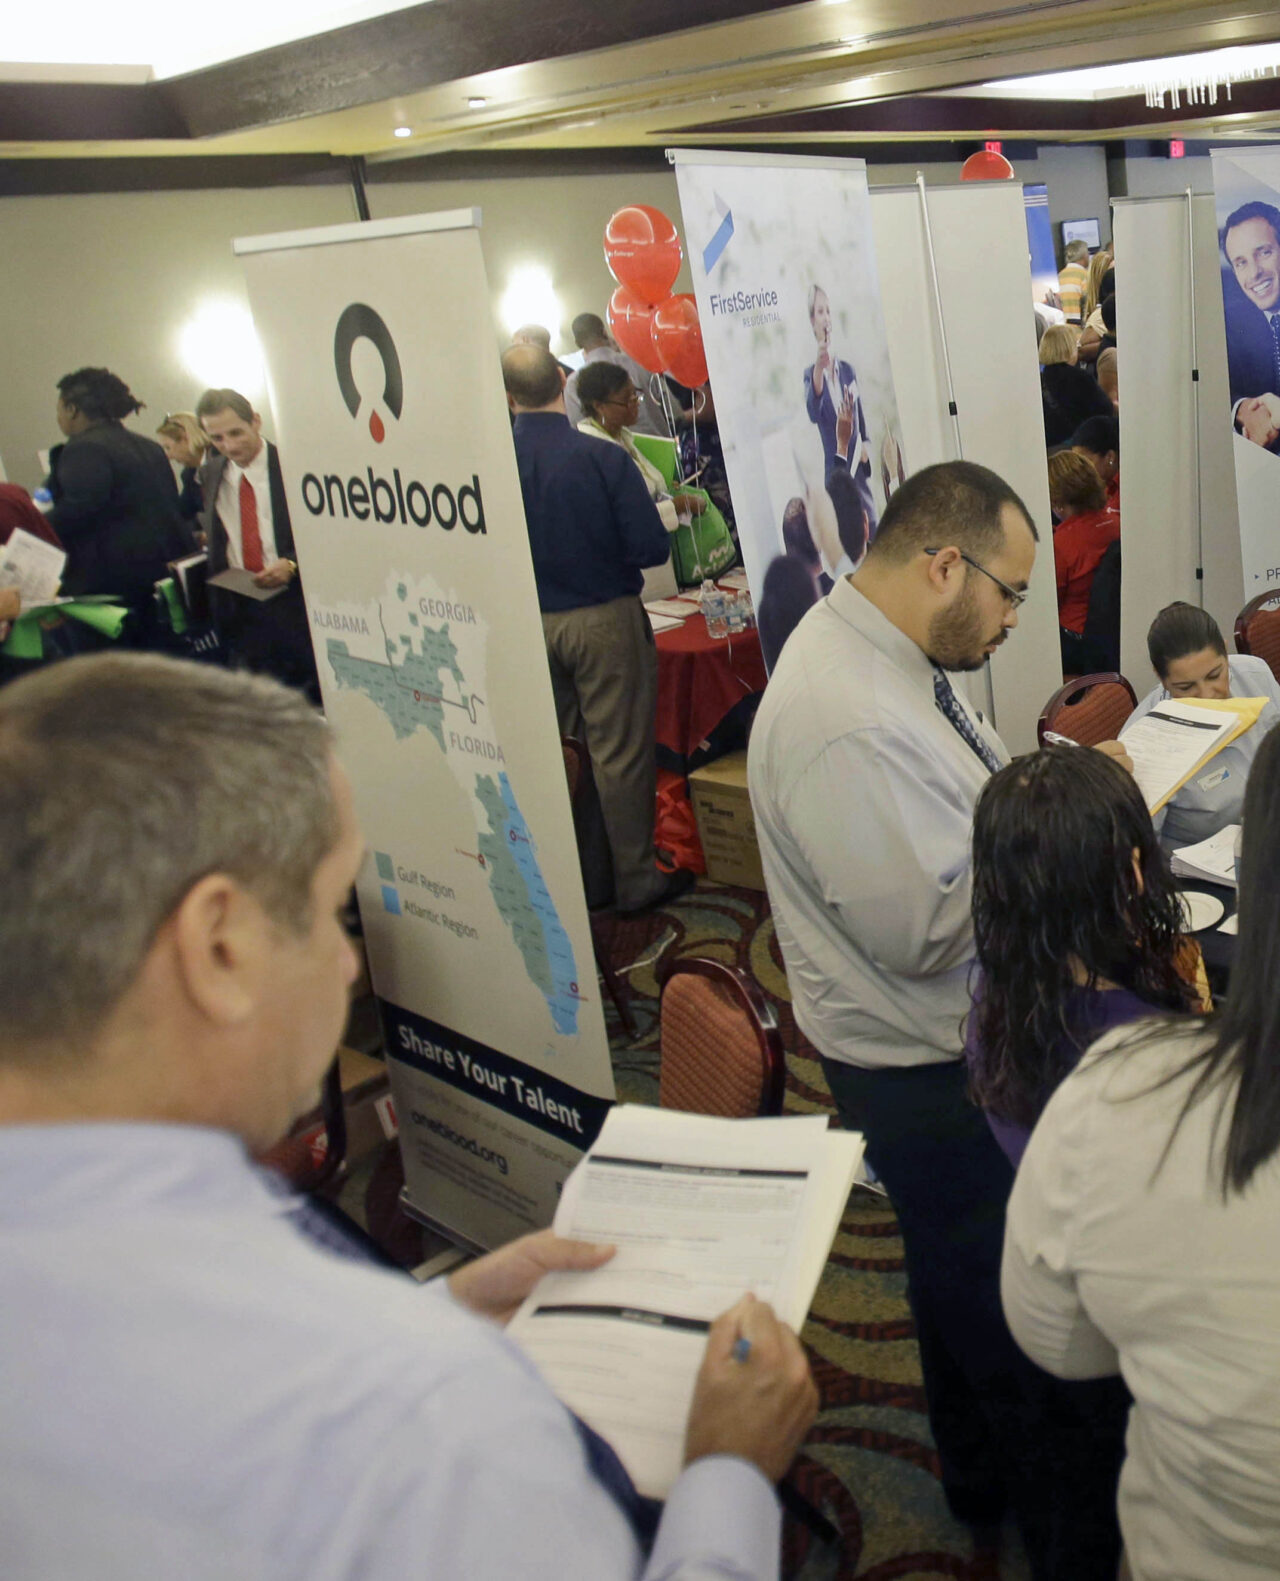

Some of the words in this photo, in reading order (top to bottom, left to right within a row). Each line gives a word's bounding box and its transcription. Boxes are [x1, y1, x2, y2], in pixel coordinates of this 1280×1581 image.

[710, 287, 778, 316] FirstService
[743, 312, 781, 328] RESIDENTIAL
[302, 467, 487, 535] oneblood
[313, 610, 369, 635] ALABAMA
[420, 598, 476, 624] GEORGIA
[450, 732, 506, 764] FLORIDA
[397, 866, 419, 885] Gulf
[421, 874, 456, 900] Region
[403, 899, 441, 926] Atlantic
[443, 914, 479, 939] Region
[399, 1025, 454, 1070] Share
[457, 1051, 507, 1095] Your
[511, 1077, 584, 1134] Talent
